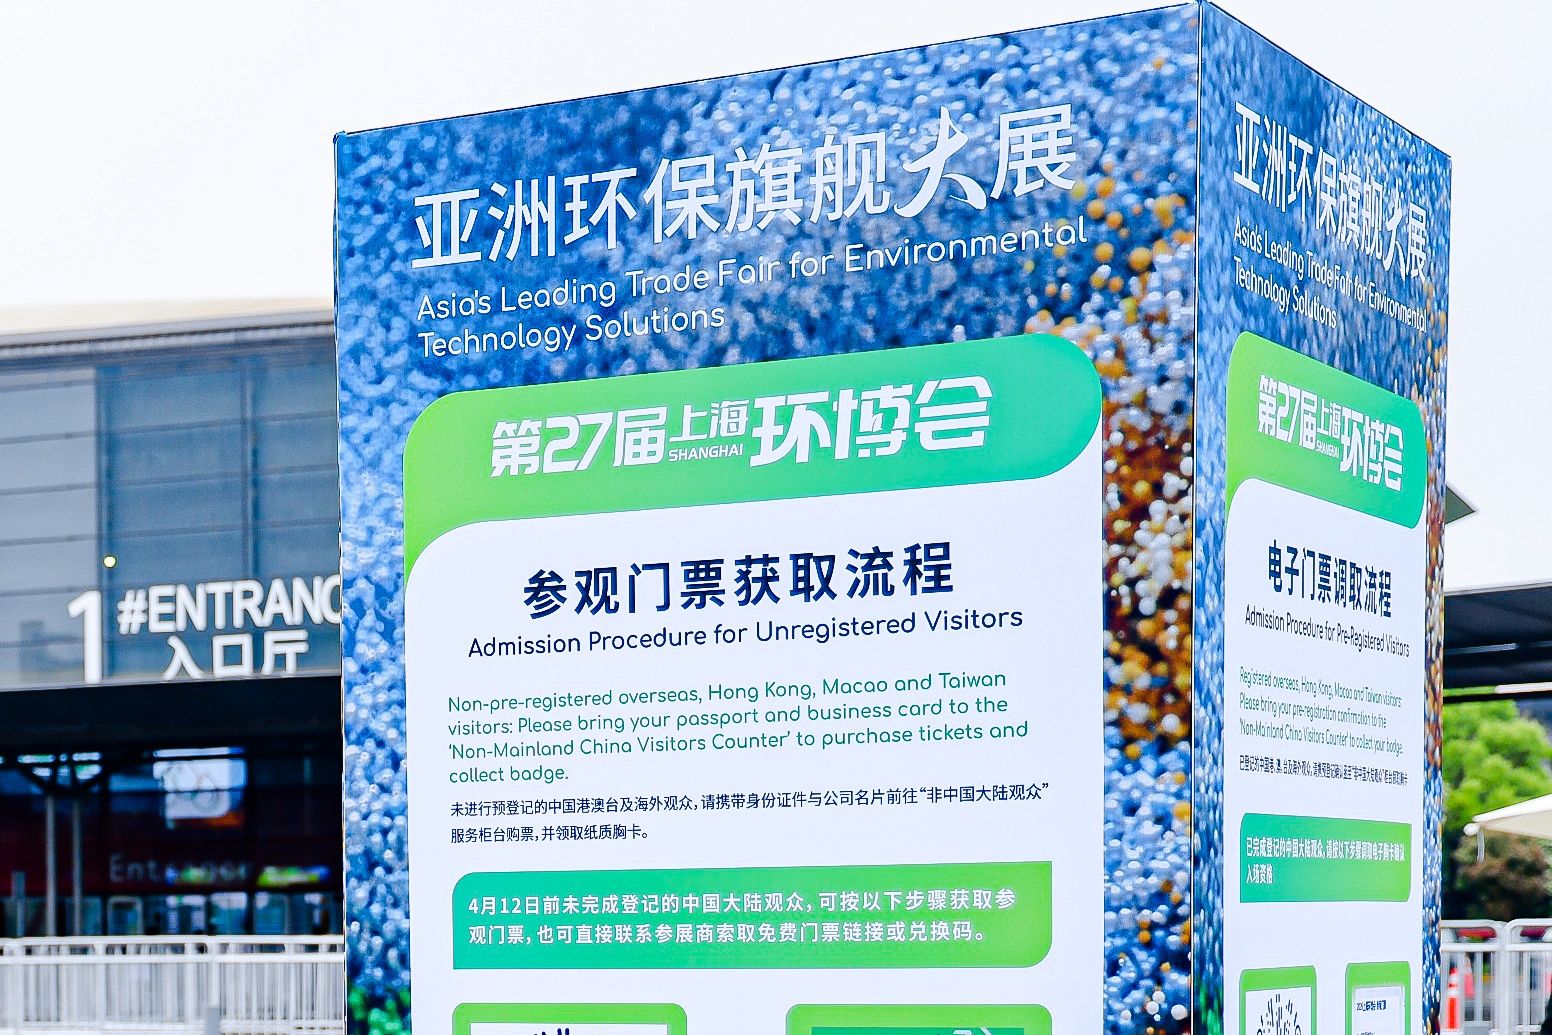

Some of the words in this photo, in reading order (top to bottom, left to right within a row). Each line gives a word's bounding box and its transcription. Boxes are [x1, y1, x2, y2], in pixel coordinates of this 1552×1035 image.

[410, 103, 1078, 269] 亚洲环保旗舰大展
[1233, 101, 1428, 285] 亚洲环保旗舰大展
[417, 289, 491, 320] Asia's
[501, 279, 616, 312] Leading
[625, 267, 709, 296] Trade
[718, 256, 780, 287] Fair
[789, 251, 834, 279] for
[845, 215, 1088, 273] Environmental
[1233, 215, 1262, 253] Asia's
[1264, 230, 1304, 280] Leading
[1306, 250, 1332, 287] Trade
[1334, 264, 1353, 297] Fair
[1354, 273, 1367, 303] for
[1369, 281, 1428, 332] Environmental
[1233, 256, 1291, 314] Technology
[1292, 285, 1337, 328] Solutions
[418, 322, 577, 358] Technology
[585, 307, 725, 341] Solutions
[489, 375, 993, 479] 第27届上海环博会
[668, 444, 744, 463] SHANGHAI
[523, 541, 953, 620] 参观门票获取流程
[1268, 539, 1392, 618] 电子门票调取流程
[67, 590, 102, 684] 1
[161, 629, 309, 680] 入口厅
[468, 634, 581, 658] Admission
[588, 626, 707, 651] Procedure
[714, 623, 747, 644] for
[755, 612, 916, 645] Unregistered
[924, 606, 1024, 632] Visitors
[1245, 604, 1285, 634] Admission
[1287, 612, 1323, 640] Procedure
[1325, 621, 1335, 642] for
[1337, 623, 1385, 652] Pre-Registered
[1386, 631, 1410, 658] Visitors
[448, 690, 612, 715] Non-pre-registered
[618, 688, 703, 705] overseas,
[708, 684, 759, 703] Hong
[765, 681, 816, 700] Kong,
[822, 678, 888, 696] Macao
[895, 674, 932, 692] and
[939, 672, 1006, 689] Taiwan
[1240, 666, 1271, 688] Registered
[1240, 692, 1260, 711] Please
[448, 720, 514, 736] visitors:
[518, 717, 572, 733] Please
[578, 715, 625, 732] bring
[630, 713, 671, 732] your
[676, 709, 758, 730] passport
[765, 705, 800, 723] and
[807, 703, 892, 721] business
[898, 699, 942, 717] card
[949, 699, 969, 714] to
[975, 696, 1008, 713] the
[580, 738, 632, 755] China
[637, 735, 706, 752] Visitors
[796, 731, 815, 746] to
[822, 728, 913, 749] purchase
[918, 724, 983, 741] tickets
[989, 721, 1028, 738] and
[1285, 724, 1302, 741] China
[1303, 726, 1325, 744] Visitors
[449, 767, 504, 783] collect
[510, 765, 569, 784] badge.
